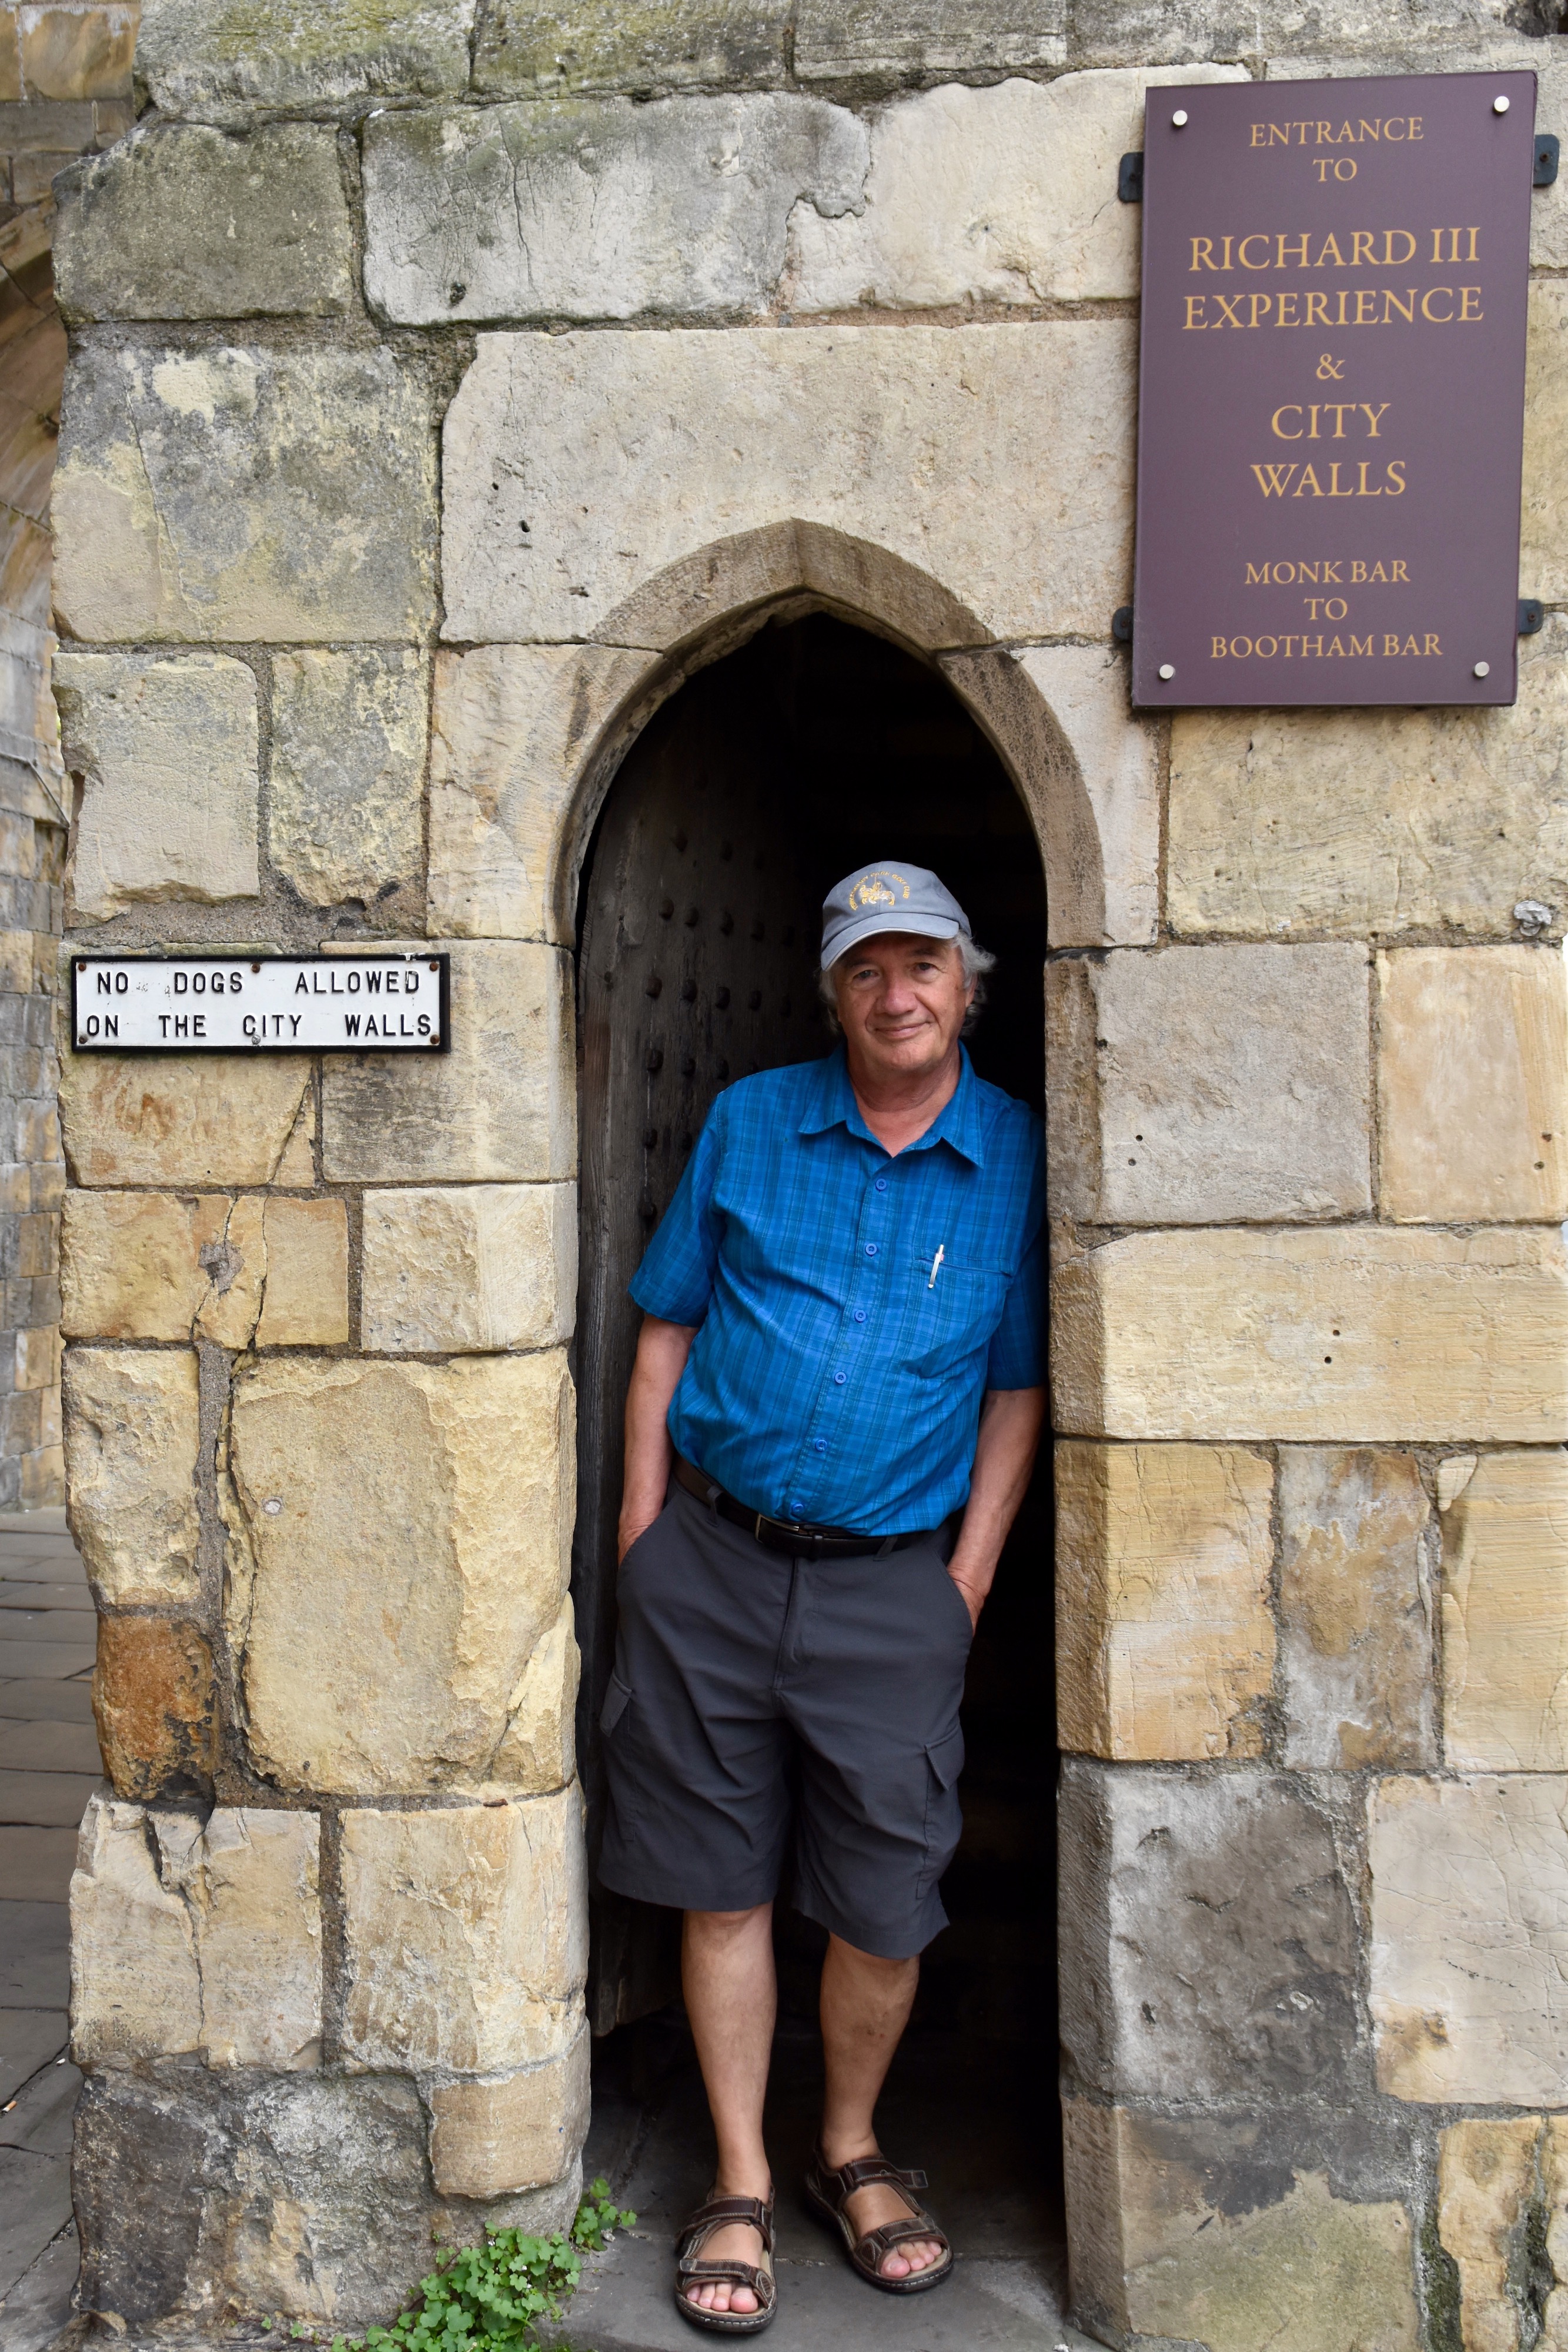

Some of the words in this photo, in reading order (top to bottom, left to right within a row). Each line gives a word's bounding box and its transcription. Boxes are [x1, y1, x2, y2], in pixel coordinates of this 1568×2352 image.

[1251, 117, 1423, 148] ENTRANCE
[1313, 158, 1358, 182] TO
[1189, 230, 1416, 272] RICHARD
[1430, 227, 1480, 263] III
[1183, 286, 1484, 330] EXPERIENCE
[1316, 353, 1344, 380] &
[1271, 403, 1390, 440] CITY
[1251, 461, 1406, 498] WALLS
[1245, 561, 1342, 585] MONK
[1351, 560, 1410, 583] BAR
[1303, 597, 1348, 621] TO
[1211, 635, 1373, 659] BOOTHAM
[1383, 633, 1442, 656] BAR
[97, 972, 128, 994] NO
[174, 972, 242, 994] DOGS
[295, 971, 420, 993] ALLOWED
[86, 1015, 118, 1037] ON
[159, 1015, 206, 1037] THE
[243, 1015, 302, 1037] CITY
[345, 1014, 431, 1036] WALLS
